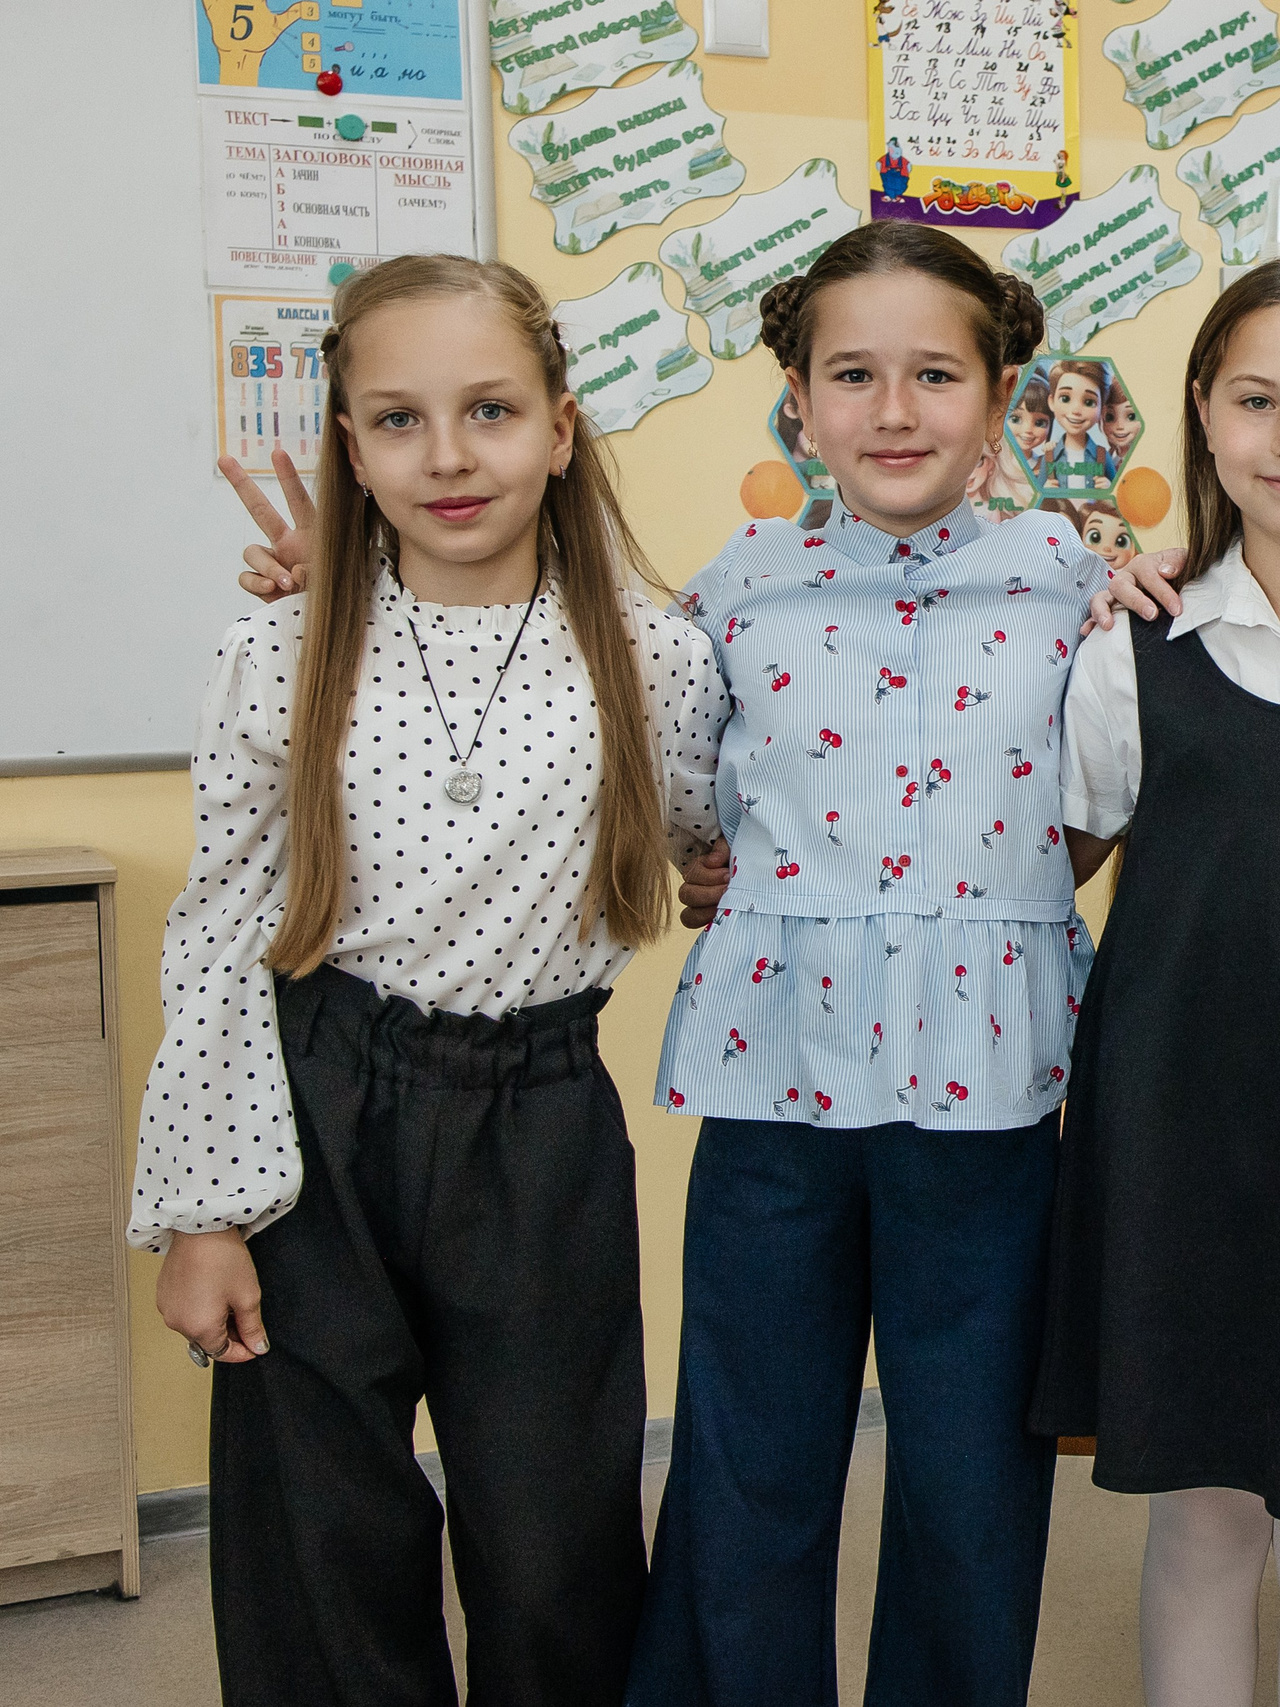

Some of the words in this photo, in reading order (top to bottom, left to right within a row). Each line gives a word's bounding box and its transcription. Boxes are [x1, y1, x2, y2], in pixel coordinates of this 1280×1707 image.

[306, 6, 315, 17] 3
[328, 11, 364, 23] могут
[521, 0, 582, 33] умного
[230, 4, 254, 41] 5
[905, 18, 921, 30] 12
[936, 22, 951, 33] 13
[1034, 30, 1049, 40] 16
[308, 37, 315, 48] 4
[514, 34, 580, 68] книгой
[578, 0, 677, 46] побеседуй
[1028, 41, 1047, 61] Оо
[1136, 50, 1183, 80] Книга
[1181, 27, 1218, 55] твой
[1219, 11, 1256, 40] друг,
[308, 58, 316, 69] 5
[983, 61, 997, 71] 20
[1145, 90, 1172, 112] без
[1198, 62, 1225, 83] как
[1224, 47, 1250, 68] без
[225, 110, 270, 126] ТЕКСТ
[313, 132, 330, 141] ПО
[333, 134, 384, 144] ССЛУ
[541, 126, 617, 163] Будешь
[617, 97, 687, 133] книжки
[428, 137, 455, 146] СЛОВА
[226, 146, 266, 159] ТЕМА
[274, 149, 373, 166] ЗАГОЛОВОК
[379, 155, 464, 172] ОСНОВНАЯ
[545, 166, 614, 197] читать,
[613, 137, 682, 172] будешь
[292, 168, 320, 181] ЗАЧИН
[394, 173, 452, 188] МЫСЛЬ
[1221, 160, 1265, 192] Книгу
[619, 178, 671, 207] знать
[293, 202, 341, 216] ОСНОВНАЯ
[342, 203, 371, 217] ЧАСТЬ
[398, 197, 447, 210] (ЗАЧЕМ?)
[294, 236, 341, 249] КОНЦОВКА
[1026, 243, 1081, 279] Золото
[1083, 196, 1154, 251] добывают
[230, 250, 318, 266] ПОВЕСТВОВАНИЕ
[700, 246, 756, 282] Книги
[754, 219, 811, 252] читать
[1062, 261, 1112, 295] земли,
[1111, 254, 1122, 266] а
[1120, 223, 1169, 260] знания
[723, 274, 775, 308] скуки
[773, 263, 795, 279] не
[277, 308, 320, 321] КЛАССЫ
[322, 309, 330, 321] И
[1089, 297, 1108, 315] из
[231, 346, 283, 379] 835
[291, 347, 329, 379] 77
